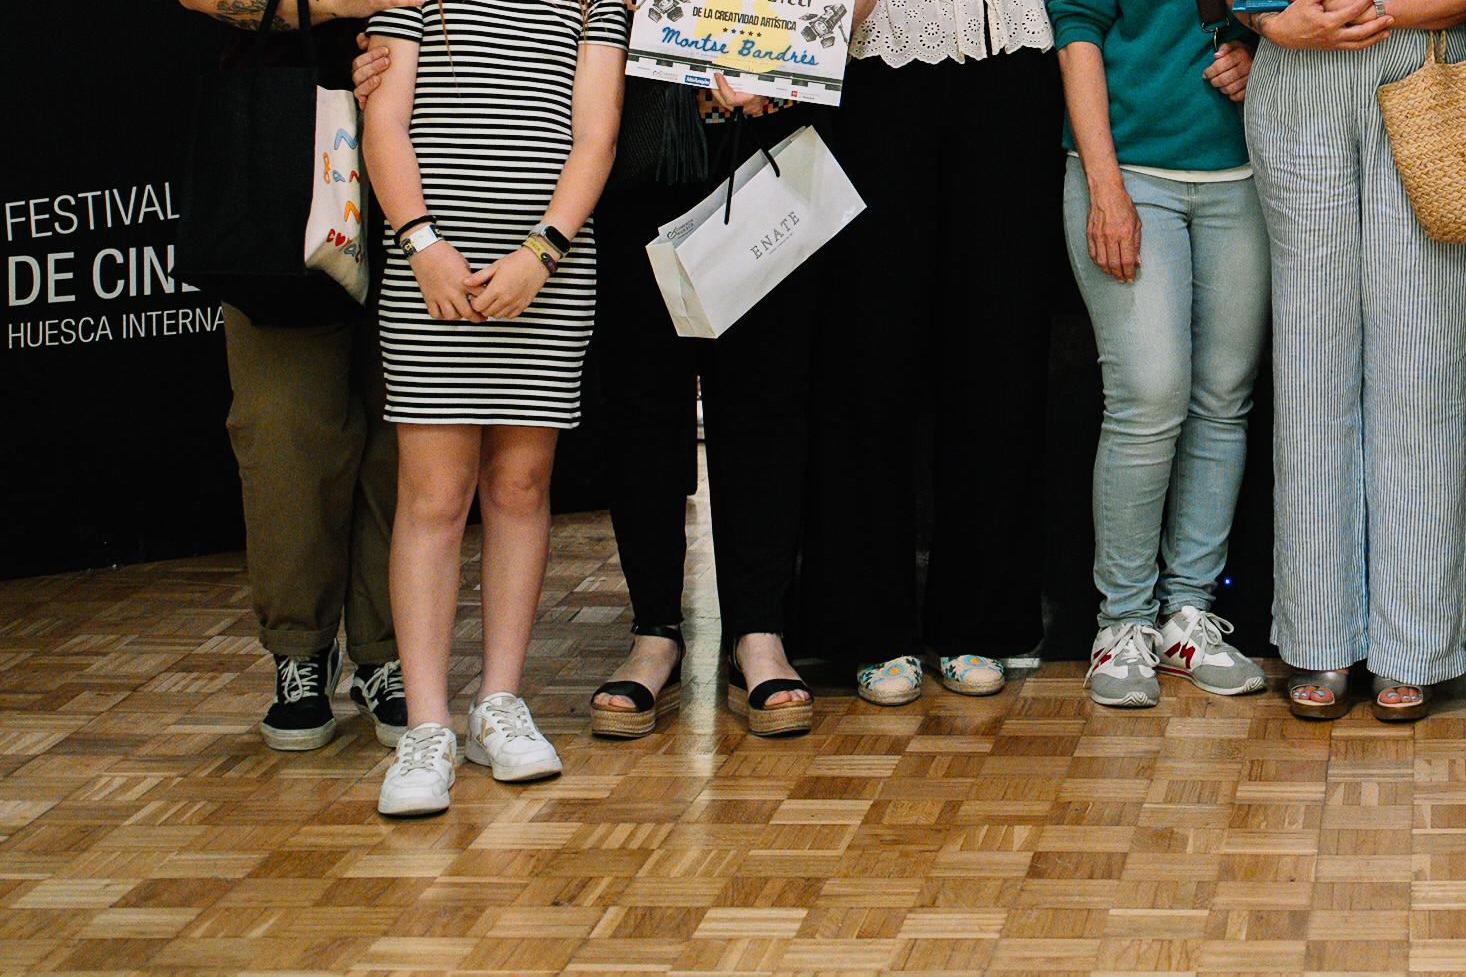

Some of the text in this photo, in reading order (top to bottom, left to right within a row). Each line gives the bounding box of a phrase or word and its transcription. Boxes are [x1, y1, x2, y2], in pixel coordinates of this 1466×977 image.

[693, 7, 702, 18] DE
[704, 8, 713, 19] LA
[760, 16, 797, 31] ARTÍSTICA
[662, 27, 819, 66] Montse Bandrés
[5, 181, 180, 241] FESTIVAL
[750, 211, 800, 260] ENATE
[8, 244, 201, 307] DE CIN
[8, 315, 113, 349] HUESCA
